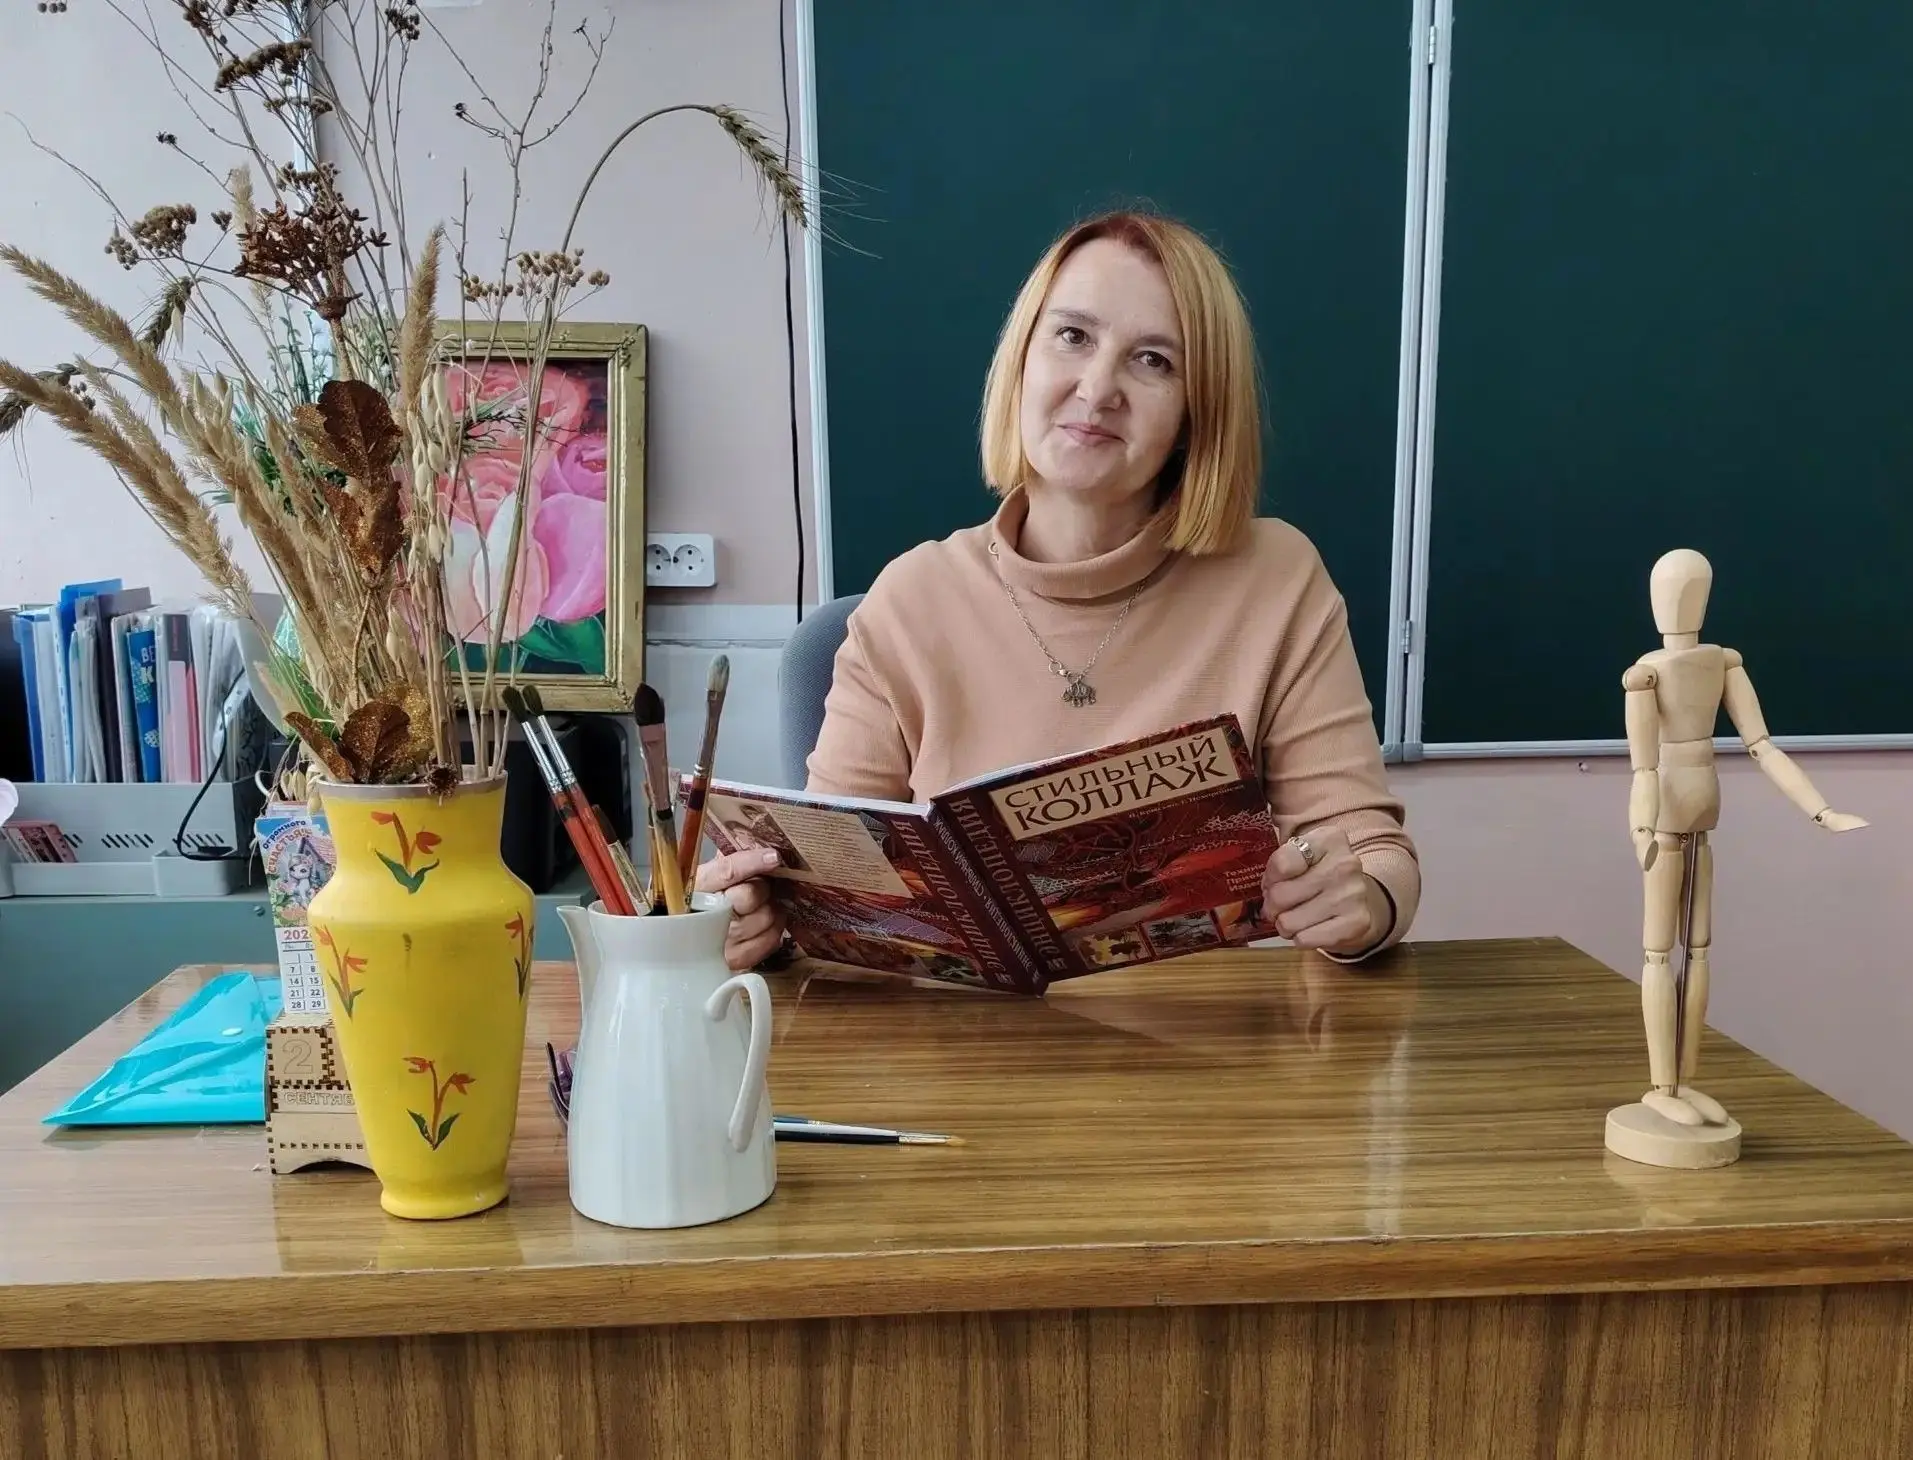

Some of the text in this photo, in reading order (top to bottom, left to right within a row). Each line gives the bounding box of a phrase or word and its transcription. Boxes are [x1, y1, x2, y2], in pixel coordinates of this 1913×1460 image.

[1004, 735, 1217, 808] СТИЛЬНЫЙ
[1014, 756, 1229, 831] КОЛЛАЖ
[262, 820, 306, 849] огромного
[934, 816, 962, 857] КОЛЛАЖ
[891, 819, 1006, 973] ЭНЦИКЛОПЕДИЯ
[950, 797, 1061, 958] ЭНЦИКЛОПЕДИЯ
[284, 929, 312, 940] 202
[984, 897, 1034, 972] ЭНЦИКЛОПЕДИЯ
[291, 1000, 321, 1009] 28 29
[282, 1039, 314, 1074] 2
